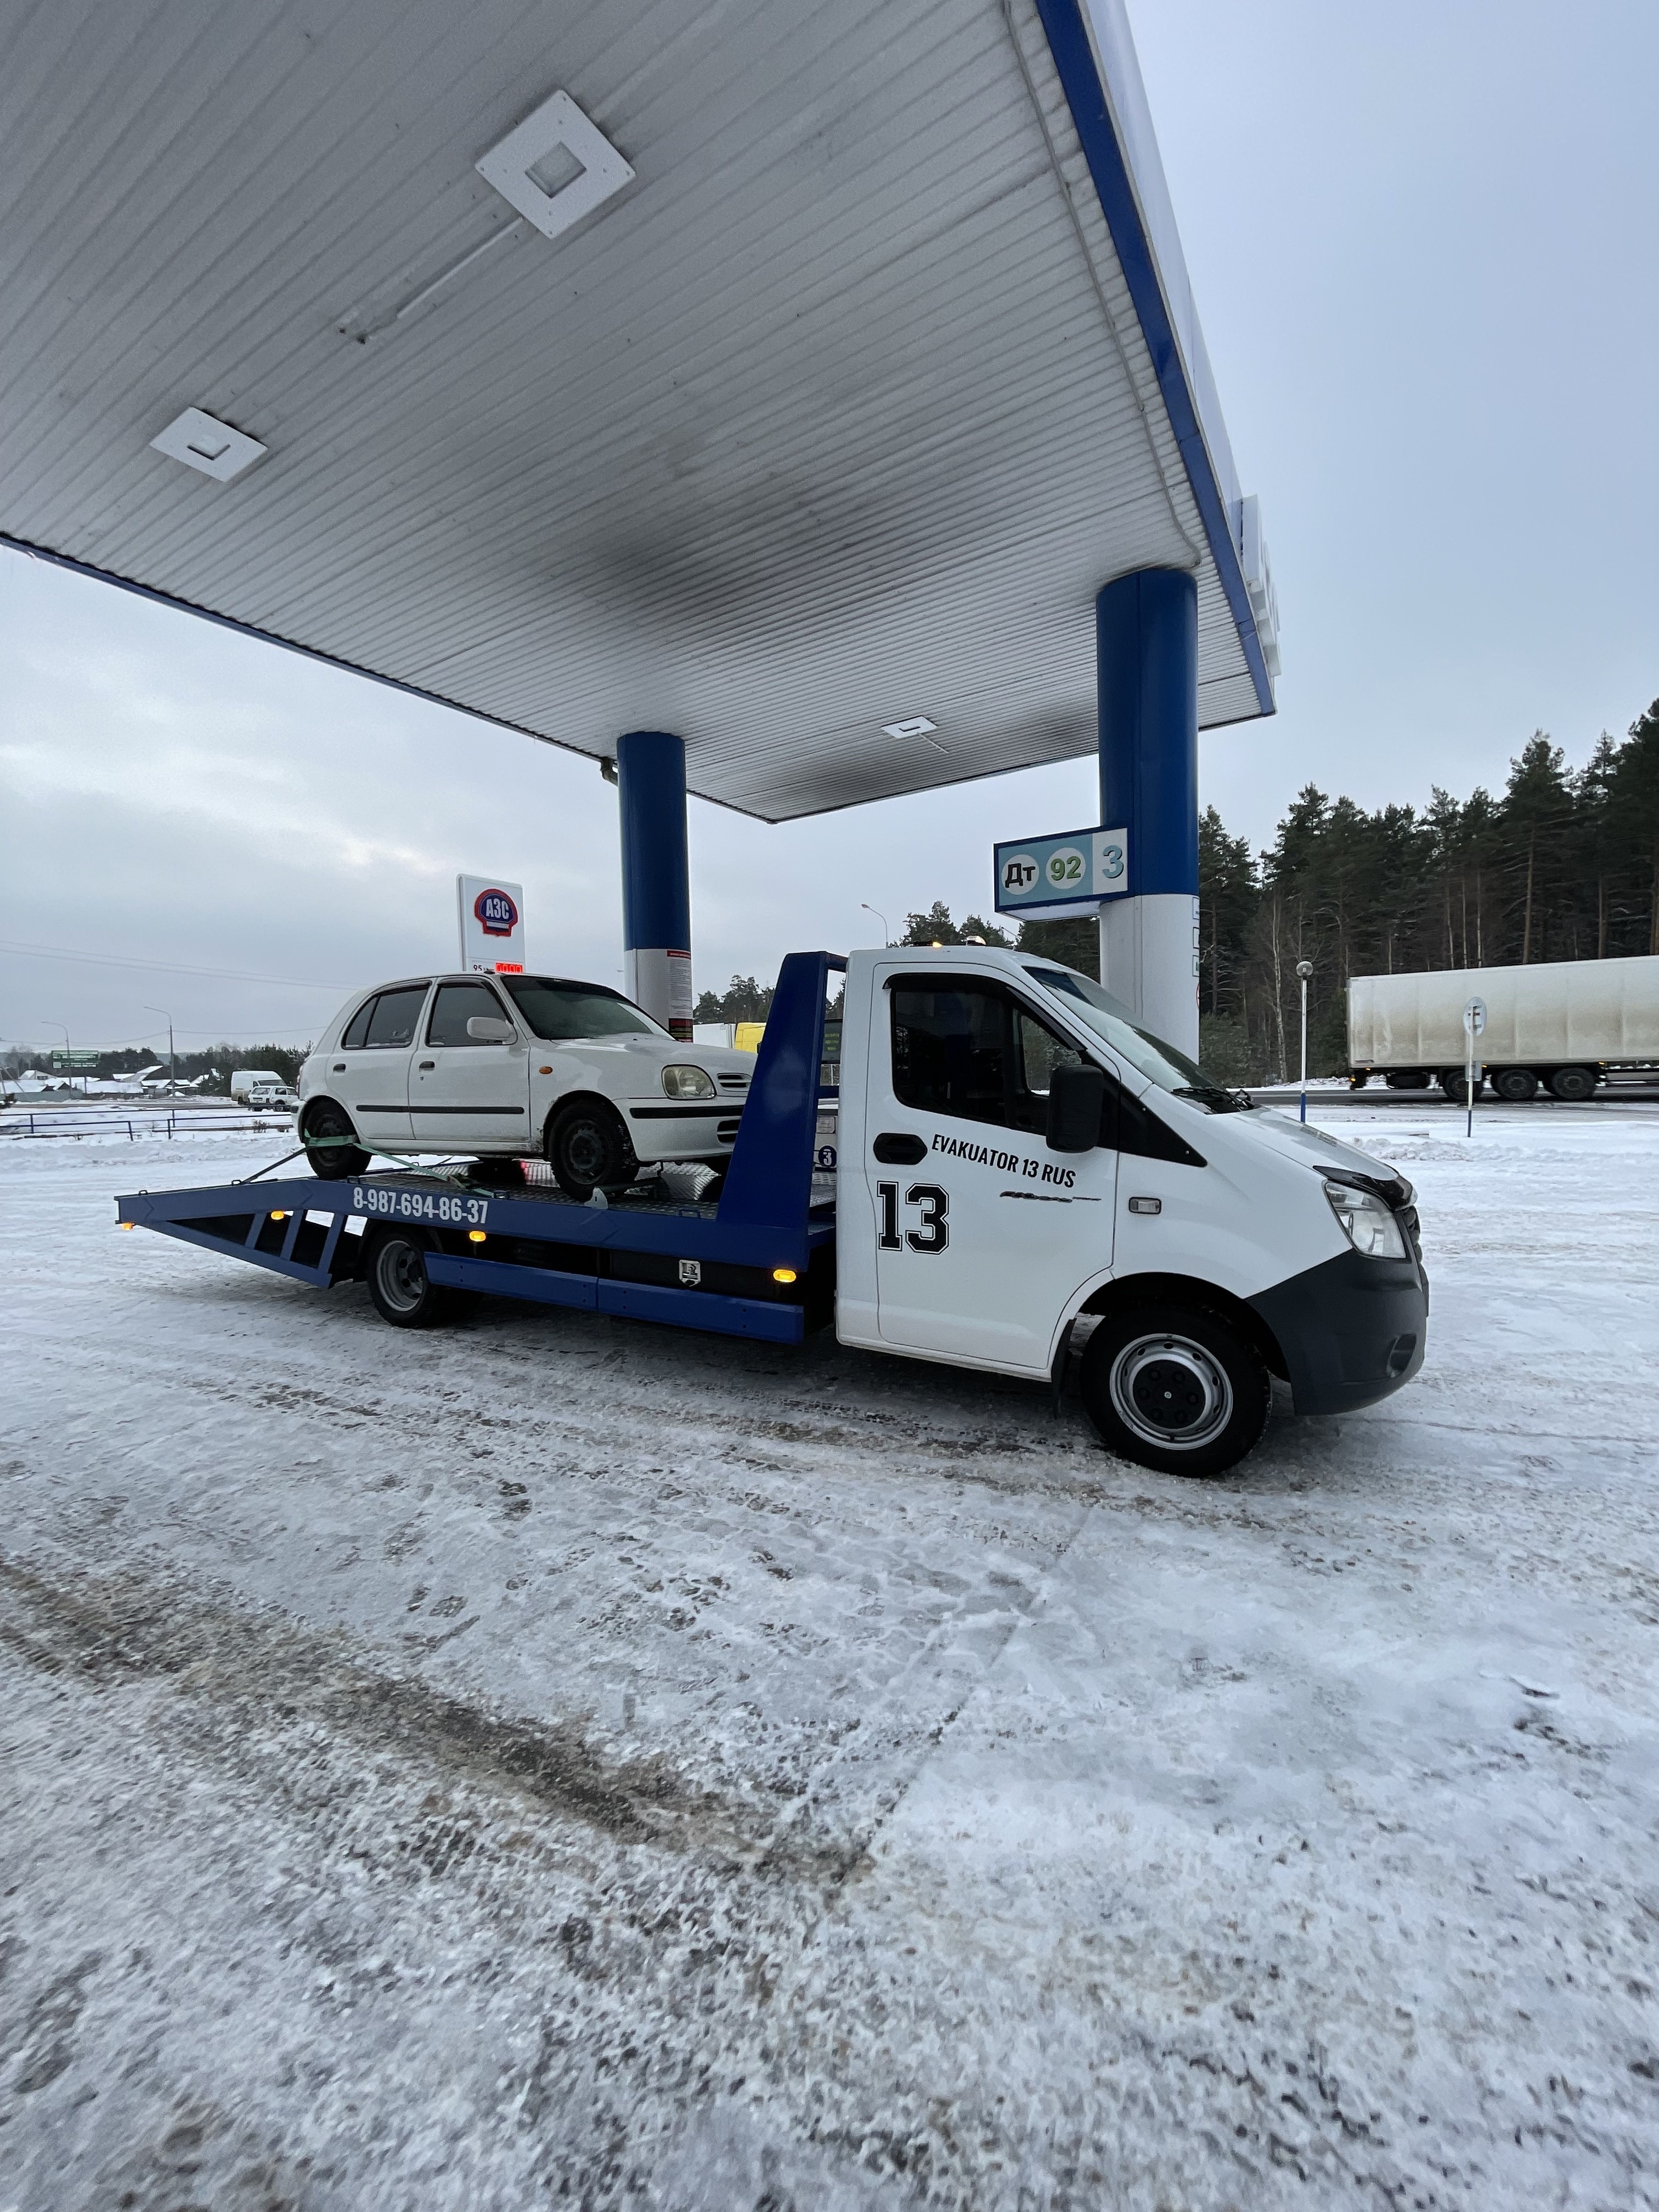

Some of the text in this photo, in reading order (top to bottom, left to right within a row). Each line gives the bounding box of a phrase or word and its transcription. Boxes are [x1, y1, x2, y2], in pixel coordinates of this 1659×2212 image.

[1006, 845, 1124, 888] Дт 92 3
[486, 898, 510, 919] АЗС
[823, 1149, 832, 1166] 3
[932, 1134, 1076, 1188] EVAKUATOR 13 RUS
[353, 1187, 488, 1223] 8-987-694-86-37
[876, 1180, 950, 1255] 13
